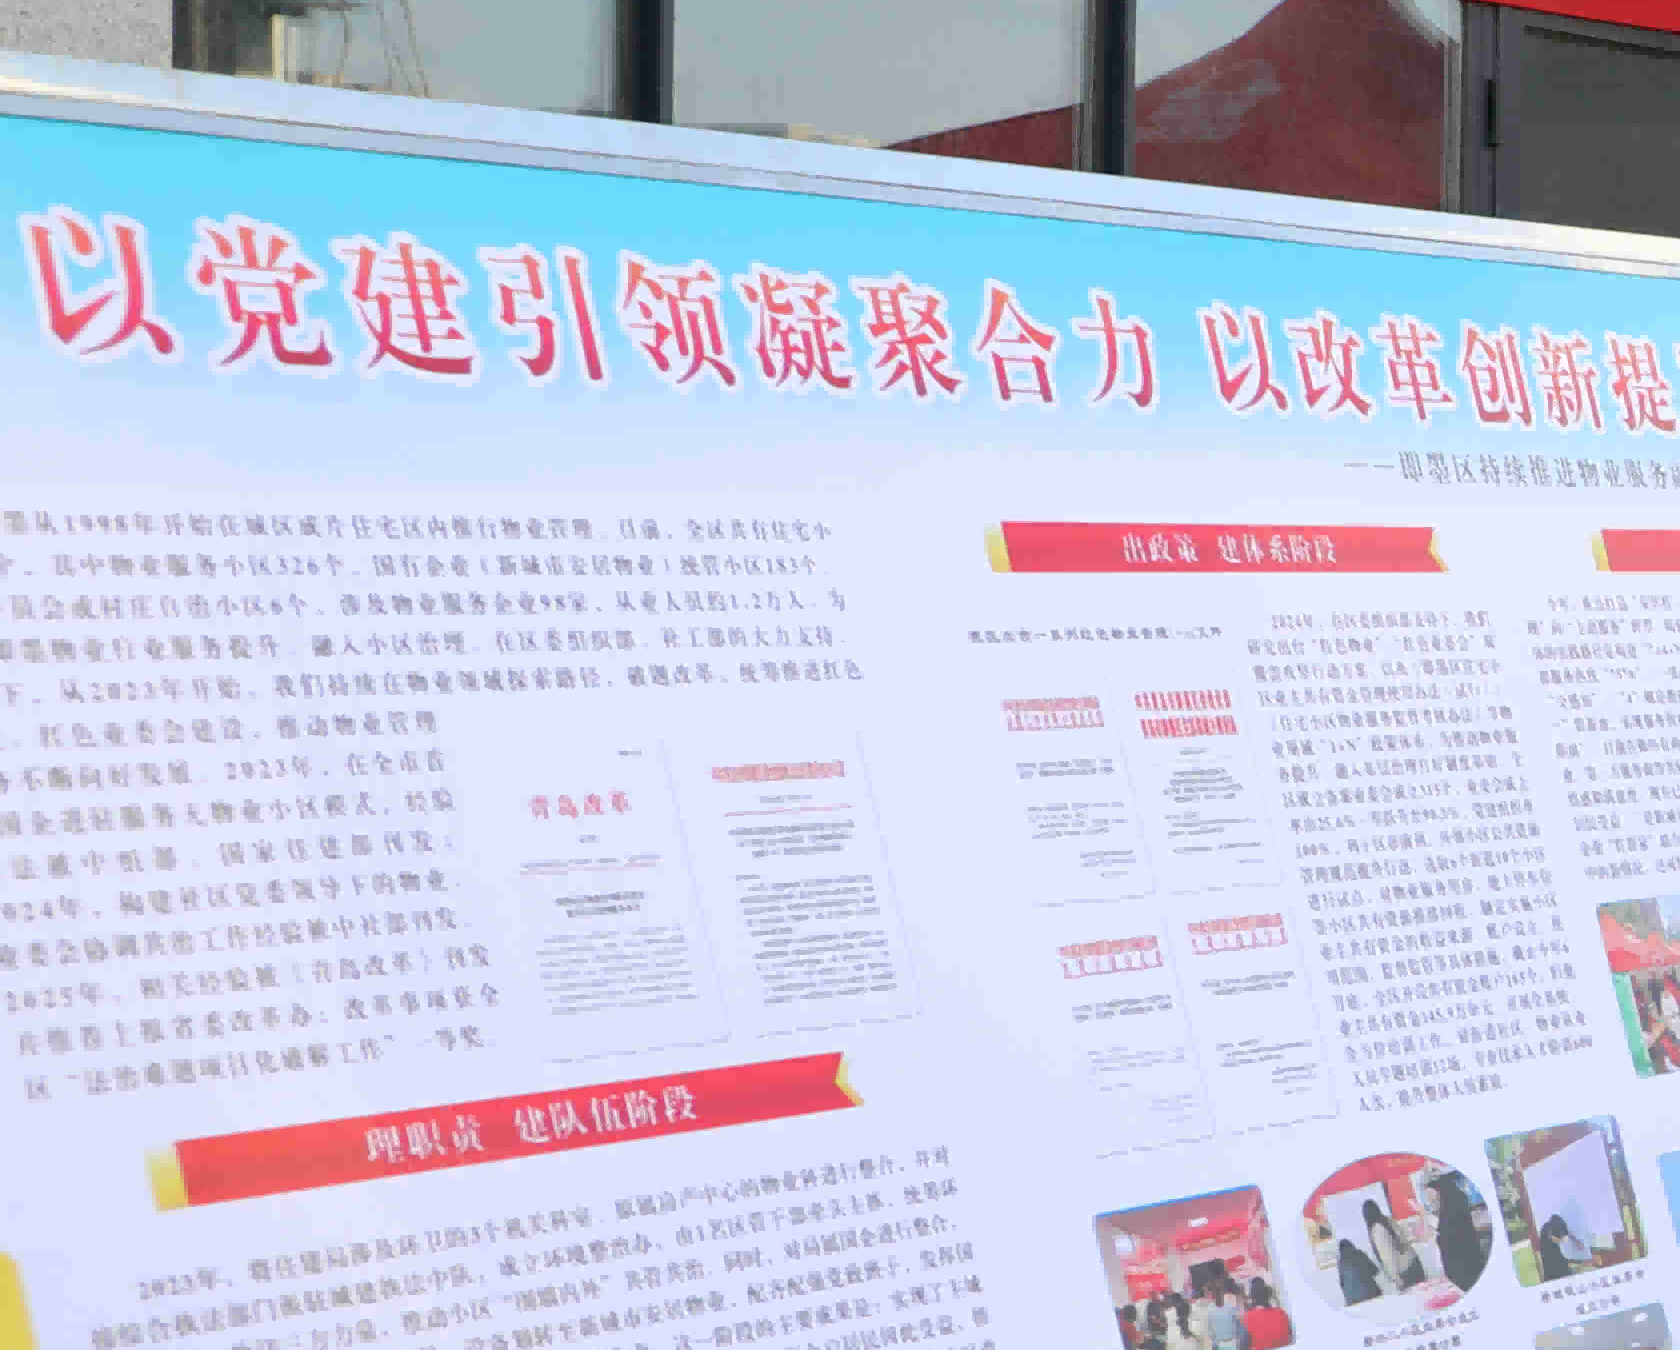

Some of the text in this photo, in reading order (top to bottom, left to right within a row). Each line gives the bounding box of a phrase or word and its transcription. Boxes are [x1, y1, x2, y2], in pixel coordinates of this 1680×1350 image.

[30, 213, 1156, 409] 以党建引领凝聚合力
